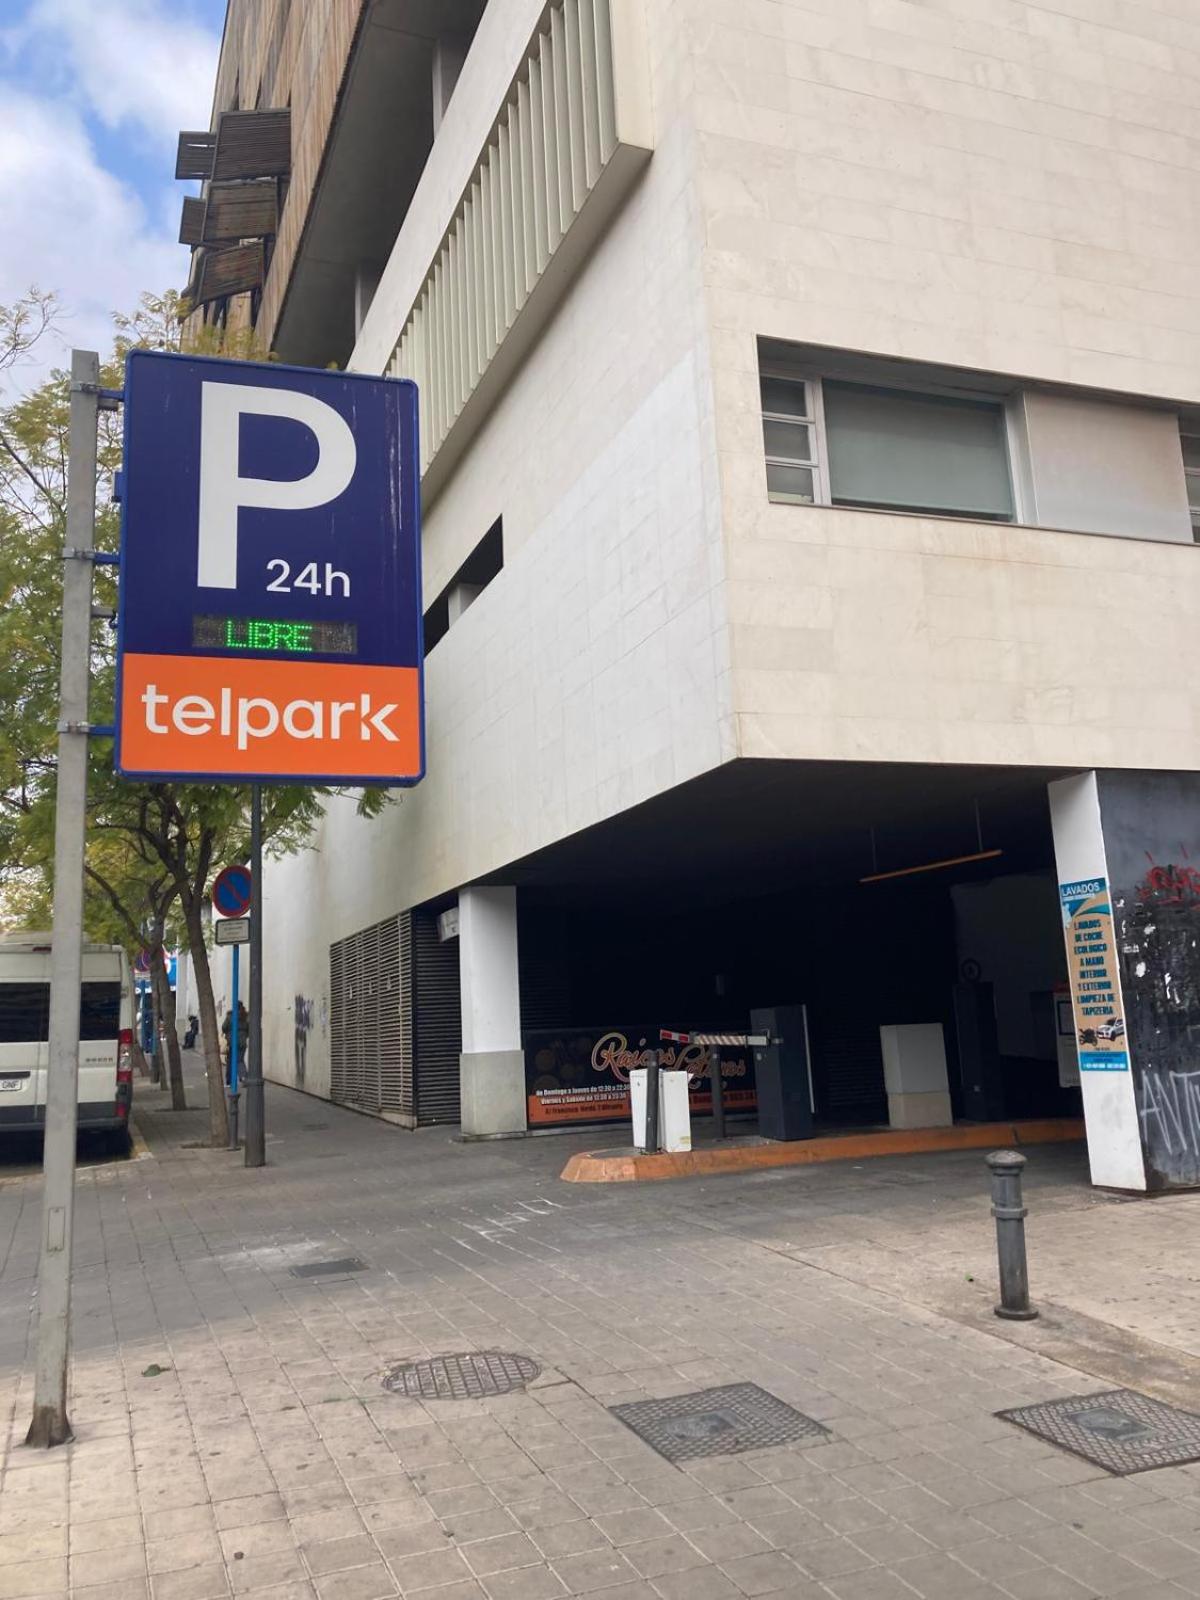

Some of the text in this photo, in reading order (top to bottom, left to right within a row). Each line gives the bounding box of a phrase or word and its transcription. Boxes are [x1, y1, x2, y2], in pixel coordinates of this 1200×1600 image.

[197, 381, 357, 590] P
[266, 558, 351, 598] 24h
[225, 619, 313, 652] LIBRE
[141, 684, 400, 751] telpark
[1061, 881, 1100, 898] LAVADOS
